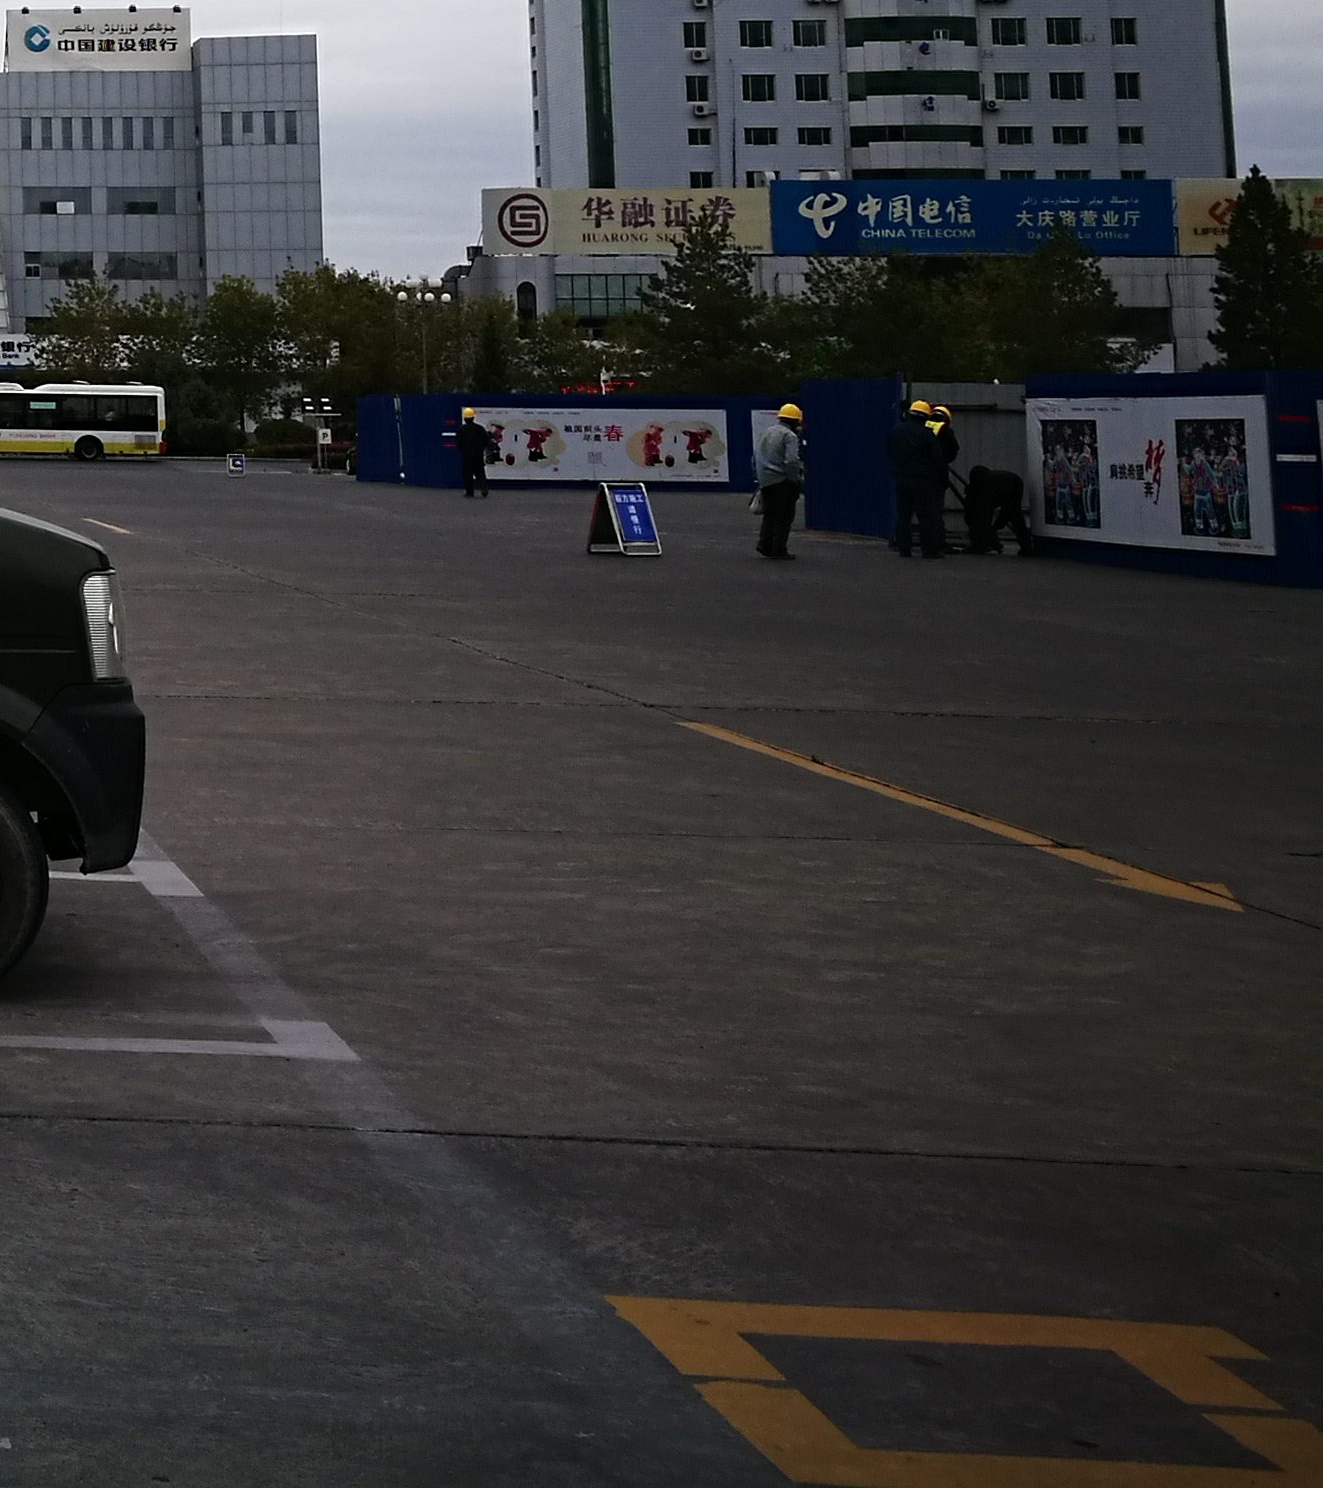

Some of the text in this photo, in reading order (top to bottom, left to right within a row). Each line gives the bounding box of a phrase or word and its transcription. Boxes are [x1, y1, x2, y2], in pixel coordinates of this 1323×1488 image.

[57, 38, 179, 52] 中国建设银行
[581, 196, 737, 228] 华融证券
[857, 192, 973, 227] 中国电信
[1015, 209, 1142, 227] 大庆路营业厅
[582, 232, 649, 243] HUARONG
[861, 228, 977, 239] CHINA TELECOM
[1096, 230, 1131, 239] Office
[604, 424, 624, 442] 春
